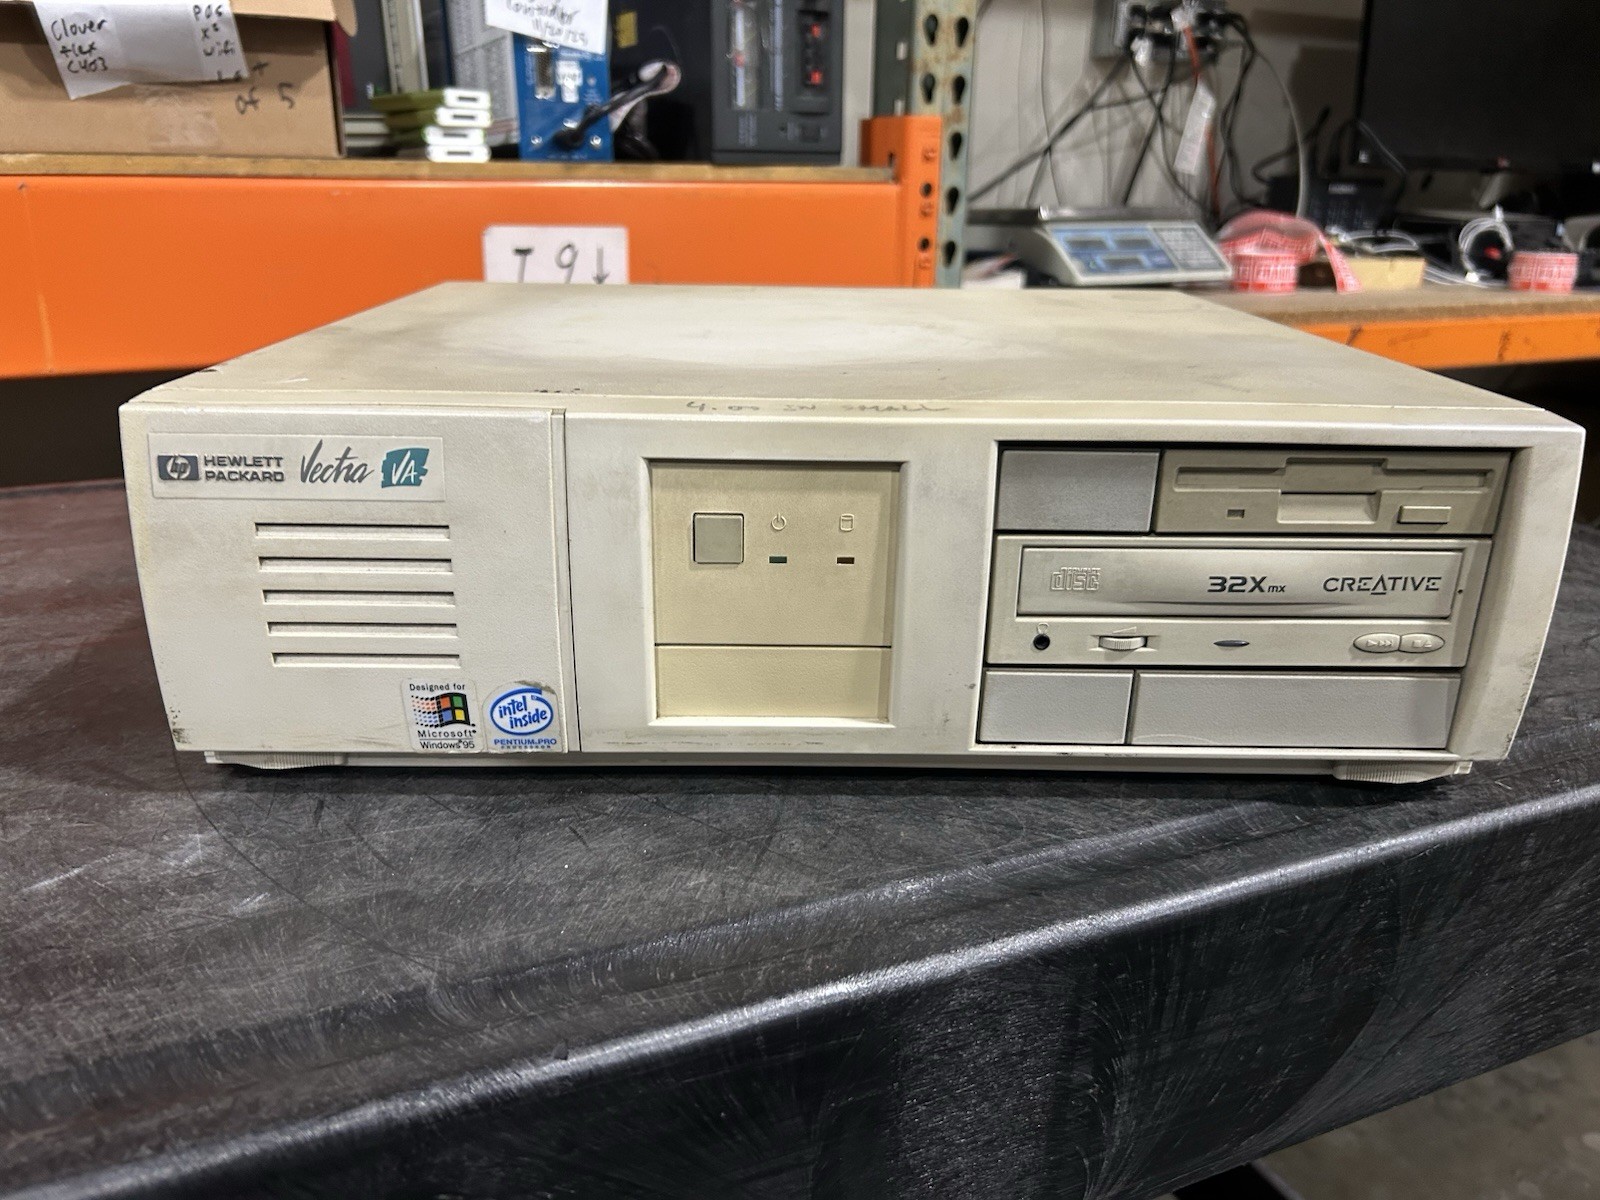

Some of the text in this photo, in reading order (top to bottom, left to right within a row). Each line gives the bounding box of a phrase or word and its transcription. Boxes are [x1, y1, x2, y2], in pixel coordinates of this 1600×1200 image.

[51, 18, 107, 41] Clover
[203, 455, 284, 468] HEWLETT
[300, 439, 418, 485] Vectra VA
[204, 470, 285, 483] PACKARD
[1323, 575, 1442, 596] CREATIVE
[409, 683, 466, 692] Designed for
[499, 696, 528, 719] intel
[509, 709, 548, 729] inside
[417, 730, 473, 738] Microsoft
